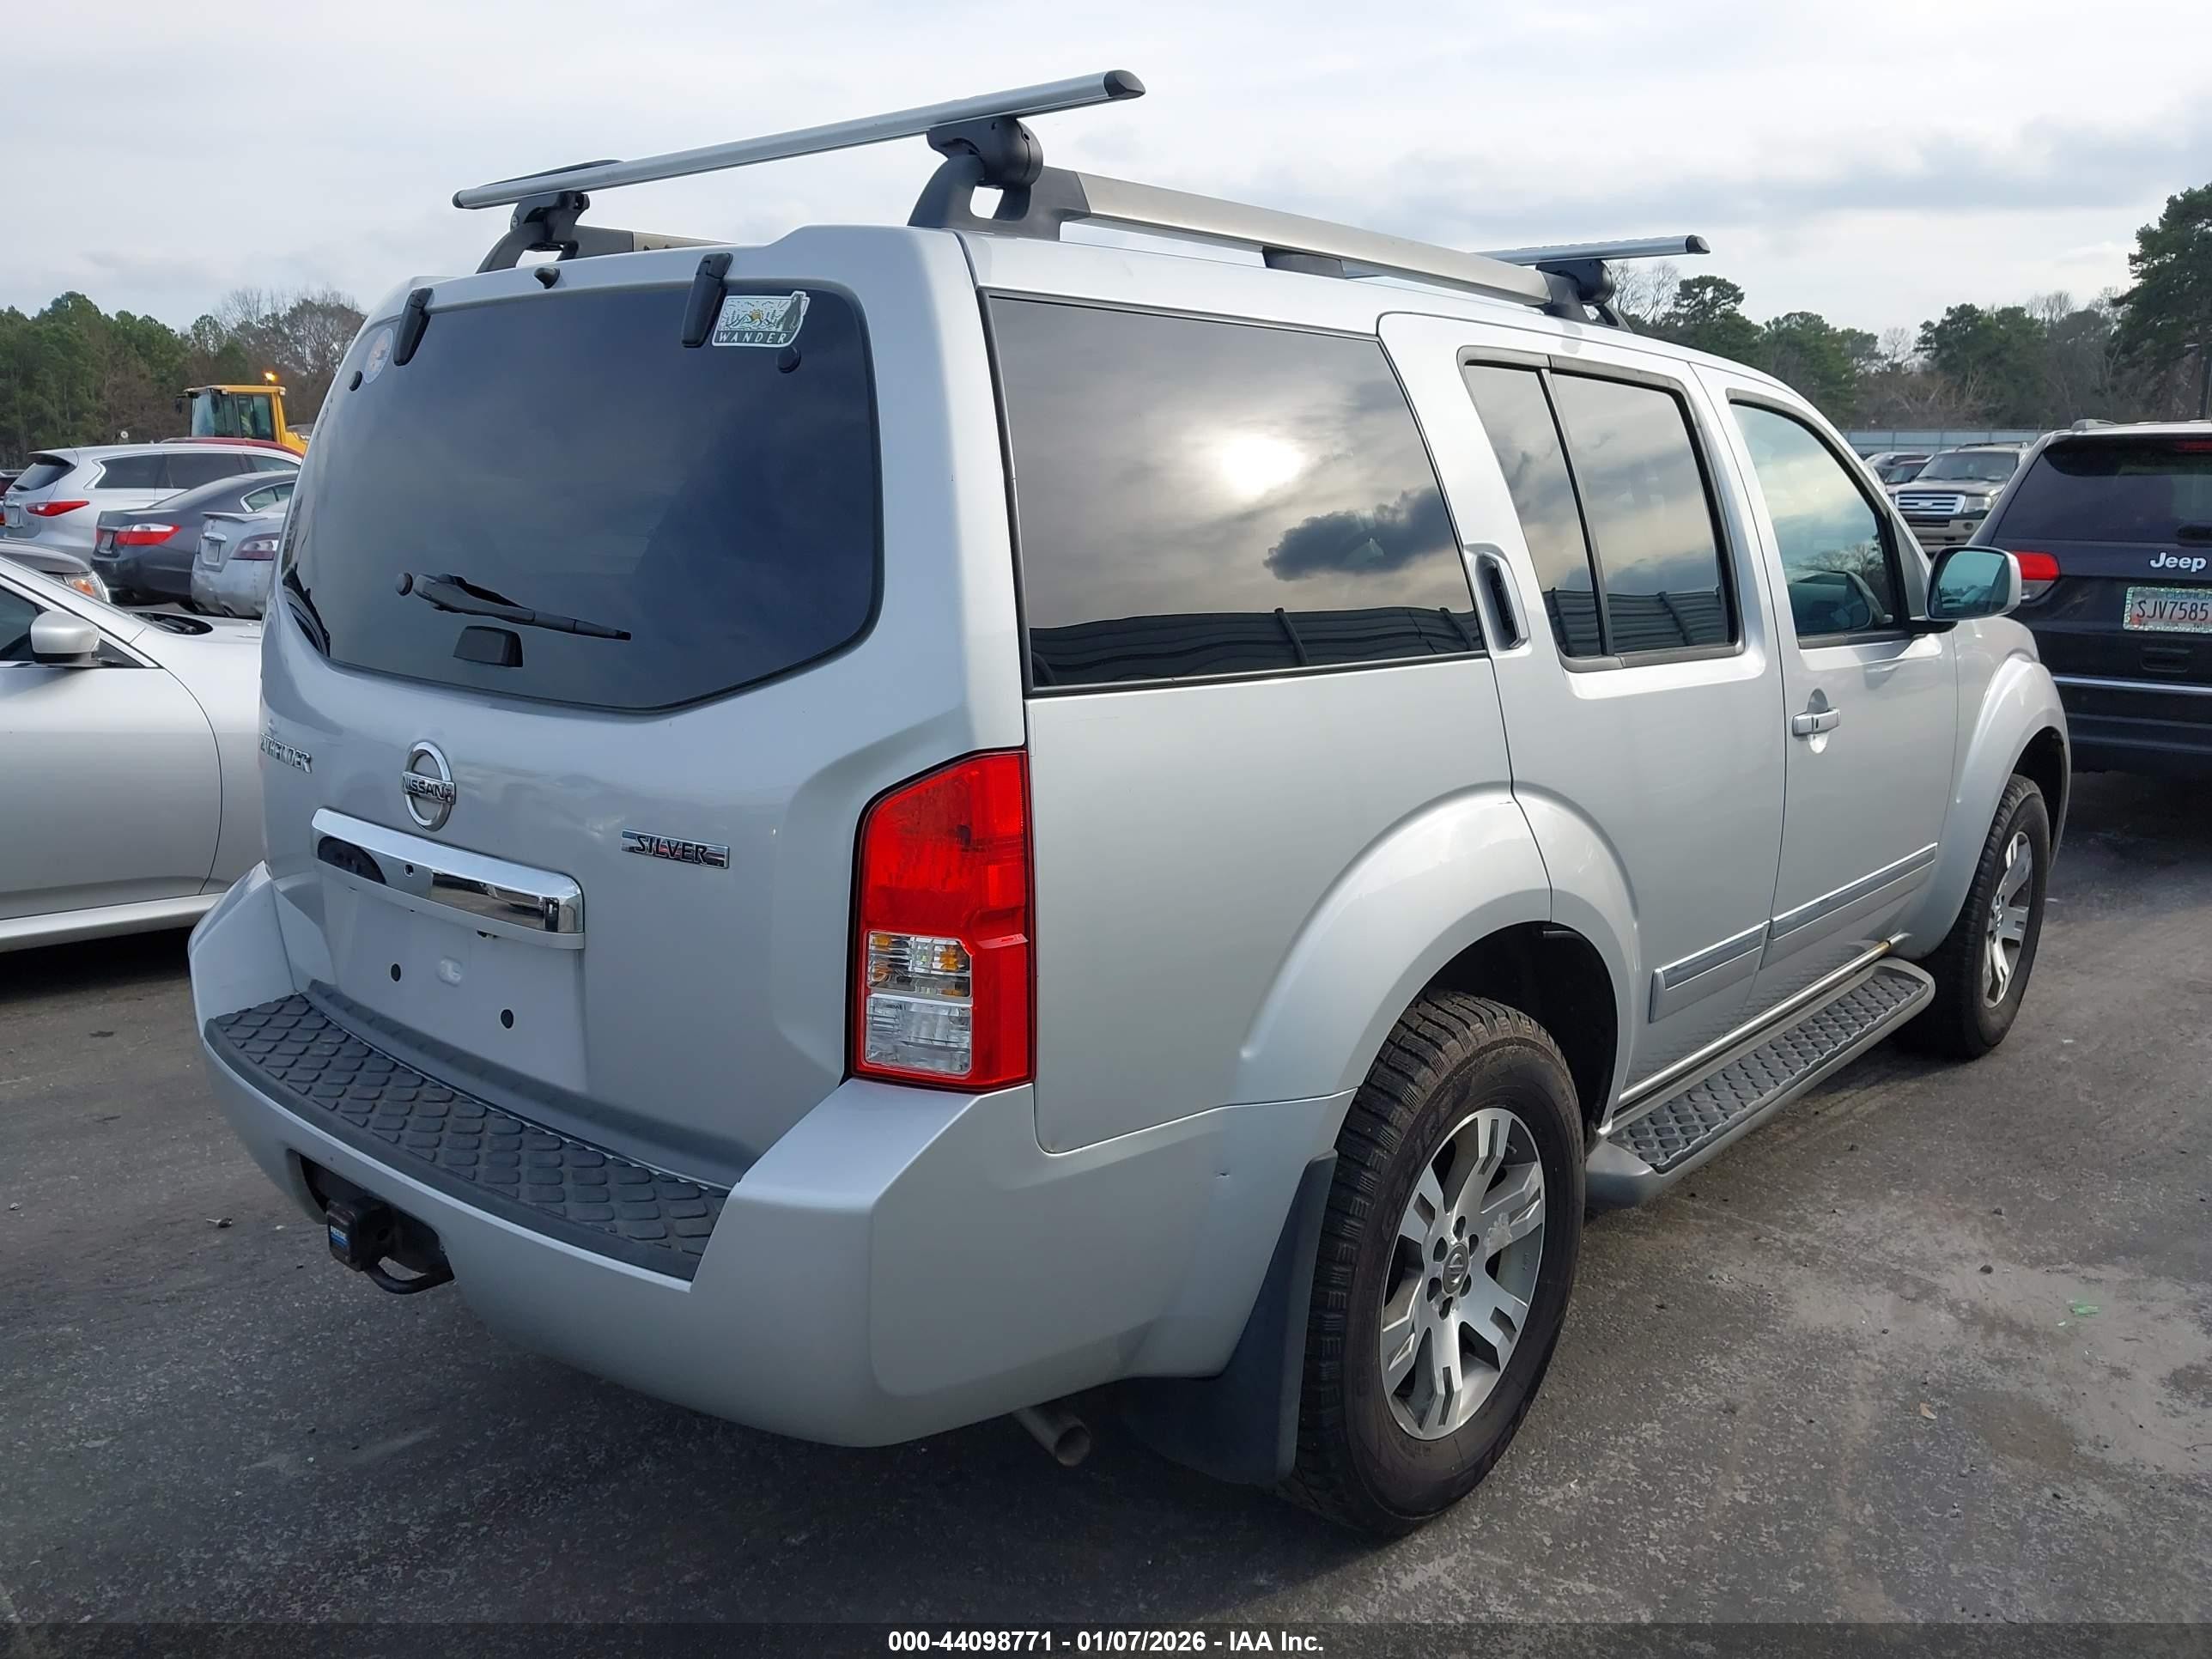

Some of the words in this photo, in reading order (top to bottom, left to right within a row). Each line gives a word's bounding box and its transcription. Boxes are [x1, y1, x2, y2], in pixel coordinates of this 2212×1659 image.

[719, 331, 787, 343] WANDER
[2149, 552, 2207, 573] Jeep
[2136, 599, 2209, 622] SJV7585
[261, 732, 312, 774] ATHFINDER
[403, 775, 445, 800] NISSAN
[635, 835, 708, 866] SILVER
